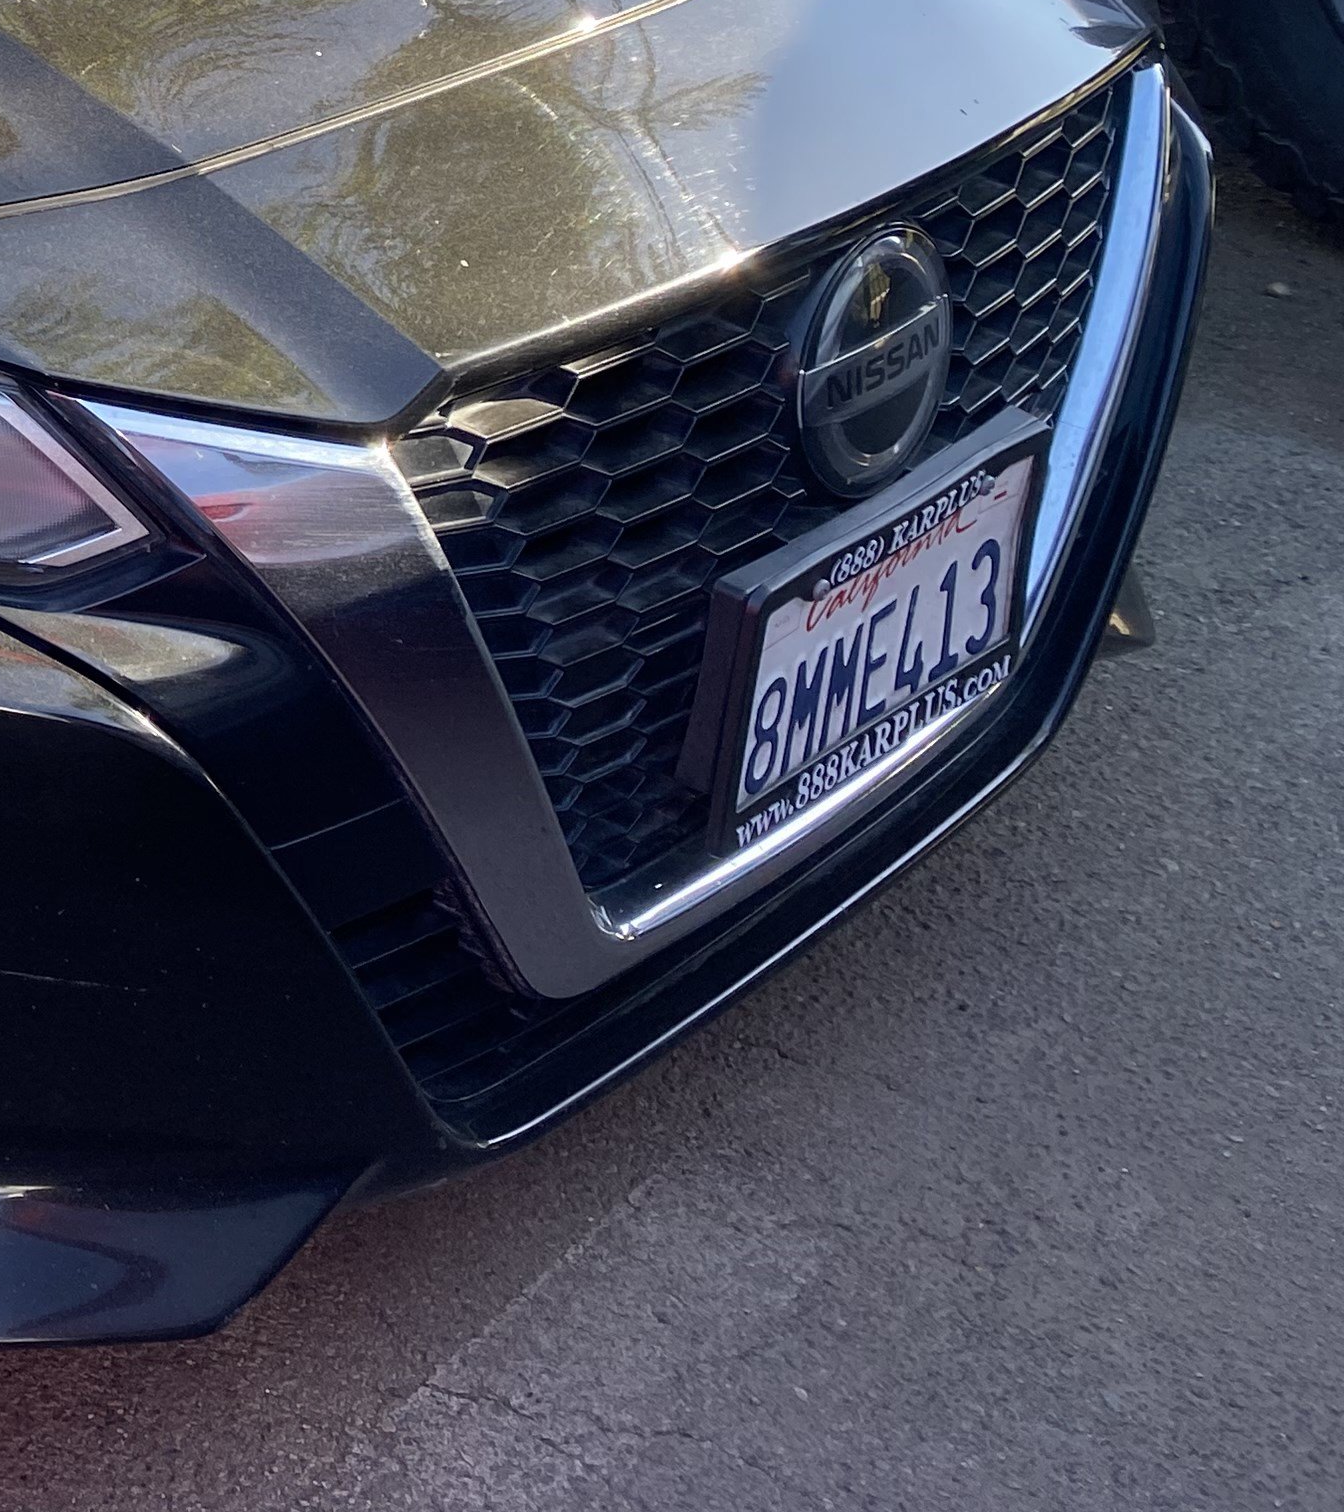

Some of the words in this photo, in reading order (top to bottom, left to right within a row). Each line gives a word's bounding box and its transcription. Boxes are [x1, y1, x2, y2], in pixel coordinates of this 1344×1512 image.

[827, 317, 940, 408] NISSAN
[830, 535, 885, 585] (888)
[888, 469, 986, 554] KARPLUS
[744, 538, 1001, 795] 8MME413
